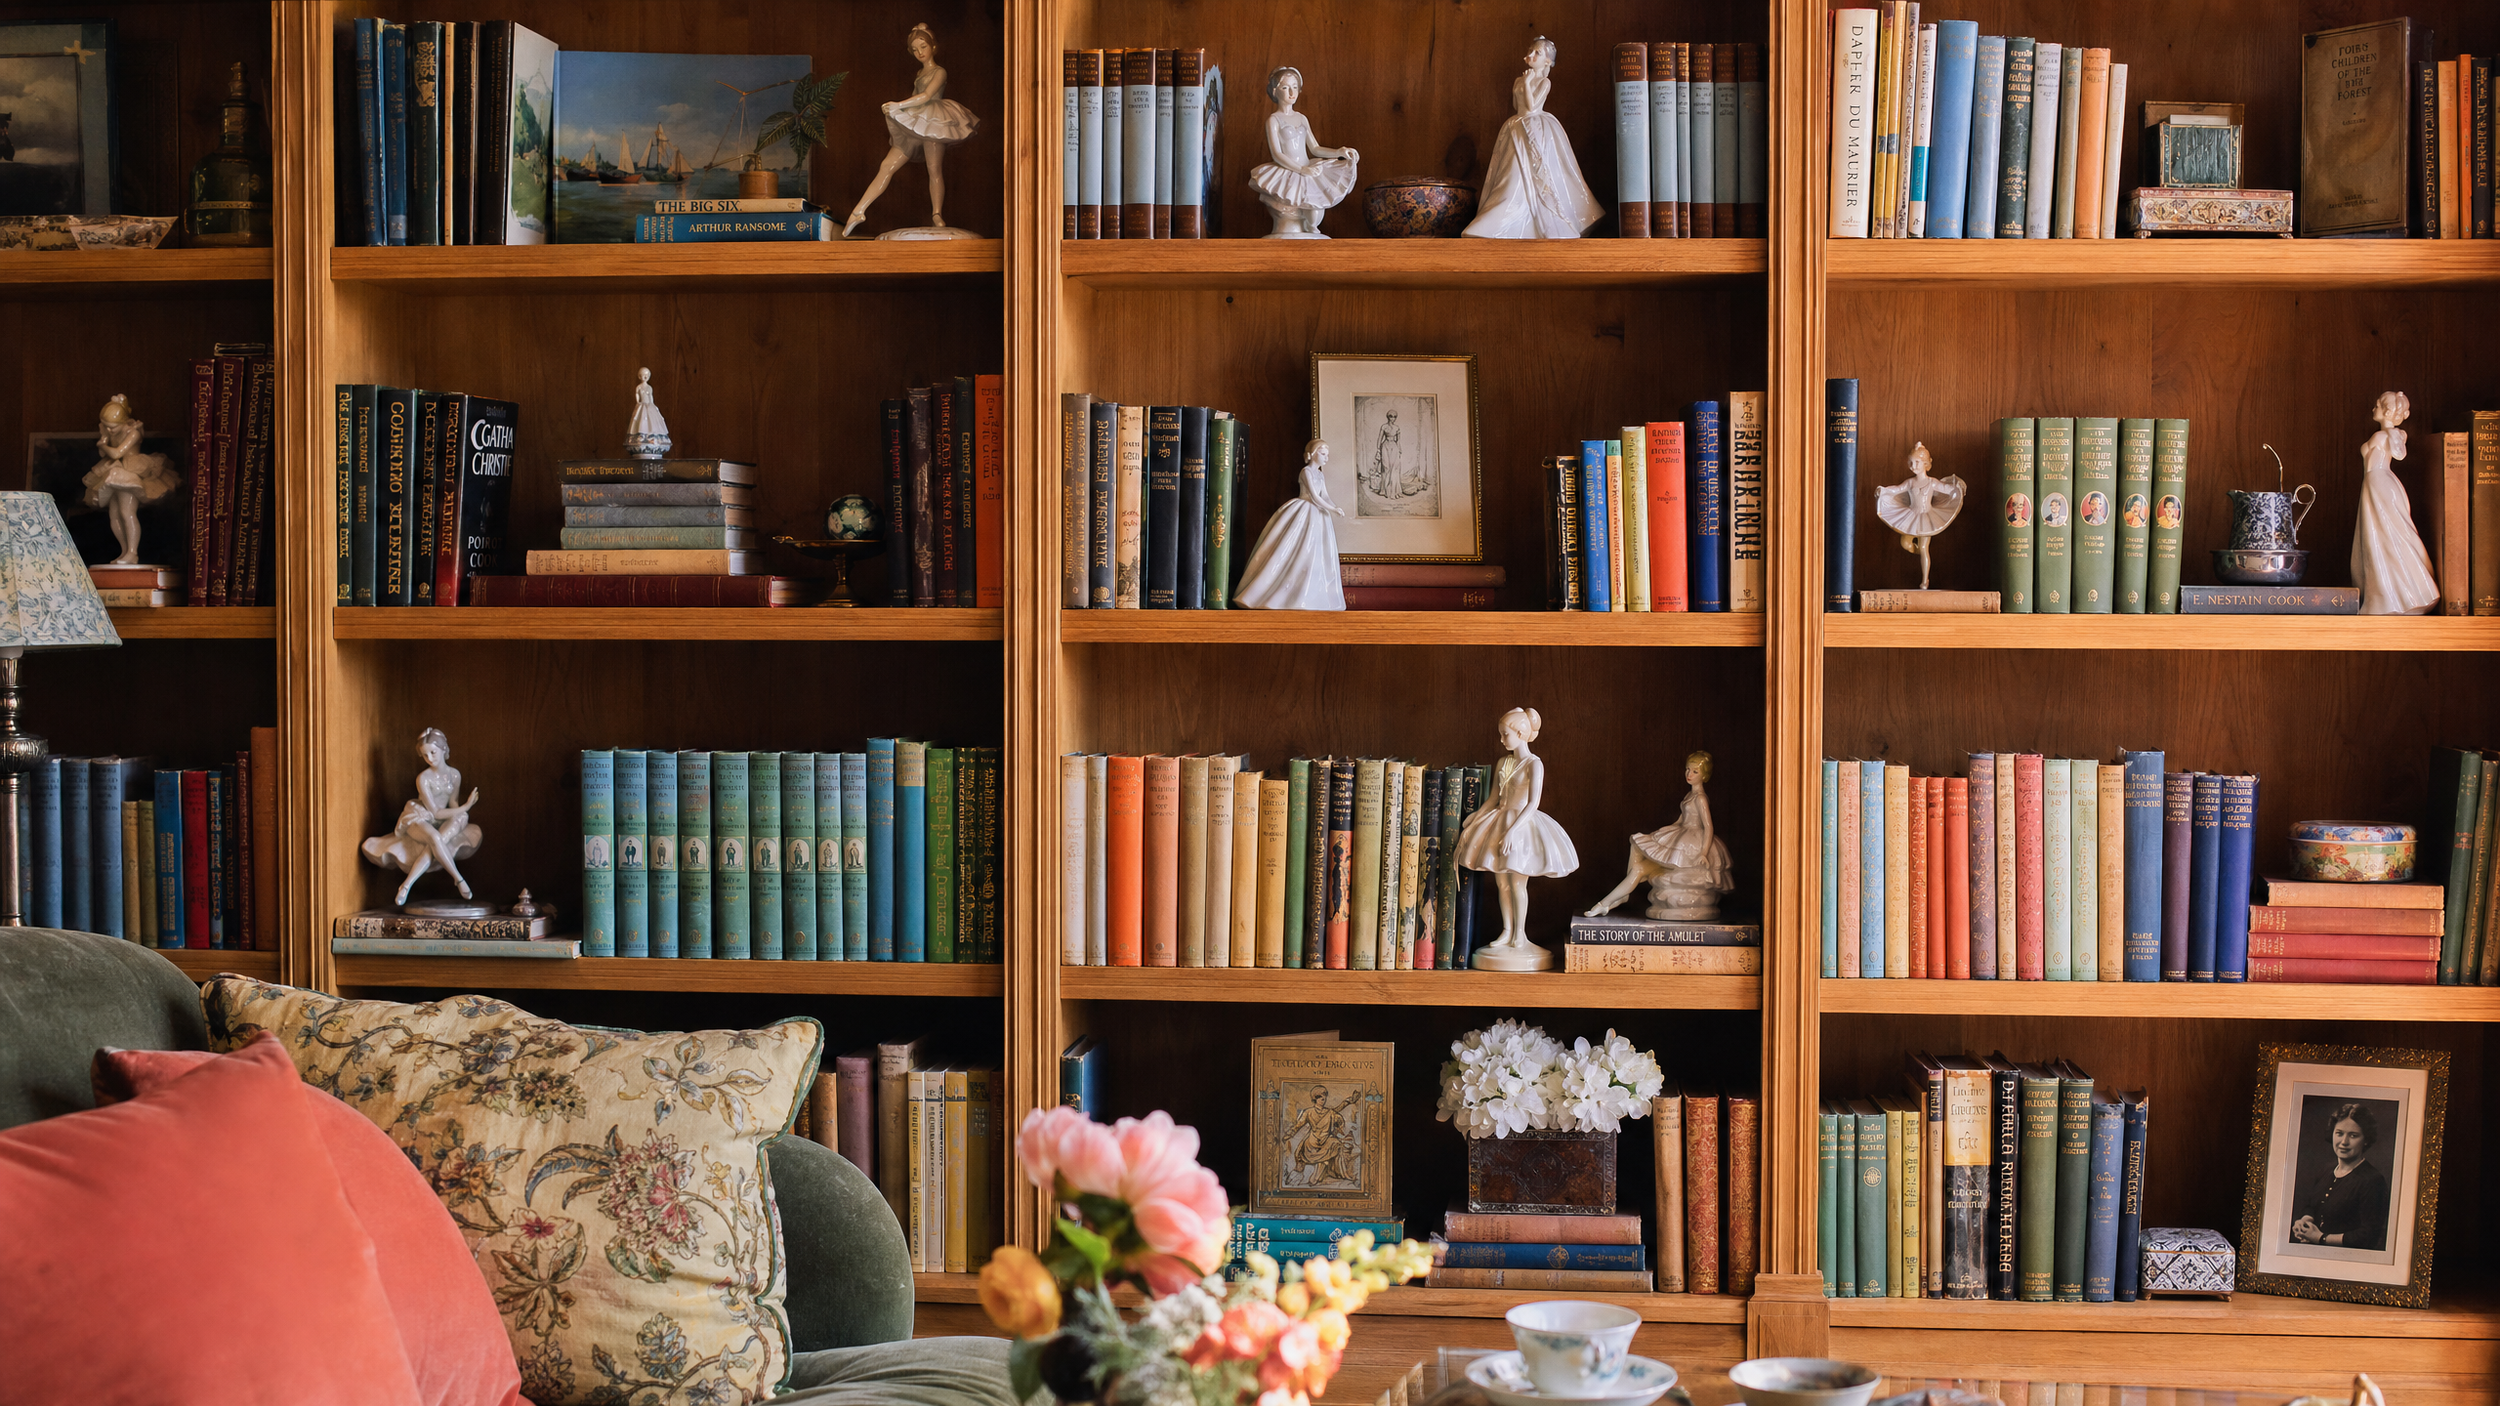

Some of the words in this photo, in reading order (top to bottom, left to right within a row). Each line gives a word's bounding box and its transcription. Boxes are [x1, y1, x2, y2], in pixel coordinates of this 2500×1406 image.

[2331, 53, 2377, 69] CHILDREN
[2337, 70, 2350, 79] OF
[2354, 66, 2371, 77] THE
[2337, 86, 2372, 101] FOREST
[1849, 105, 1861, 129] DU
[1846, 136, 1860, 207] MAURIER
[659, 201, 686, 212] THE
[690, 201, 713, 212] BIG
[717, 200, 742, 212] SIX.
[688, 223, 732, 233] ARTHUR
[735, 222, 787, 232] RANSOME
[472, 451, 512, 477] CHRISTIE
[2193, 594, 2204, 606] E.
[2208, 594, 2262, 606] NESTAIN
[2268, 595, 2305, 606] COOK
[1578, 929, 1597, 941] THE
[1599, 930, 1630, 942] STORY
[1632, 930, 1645, 942] OF
[1646, 930, 1665, 942] THE
[1667, 930, 1706, 943] AMULET
